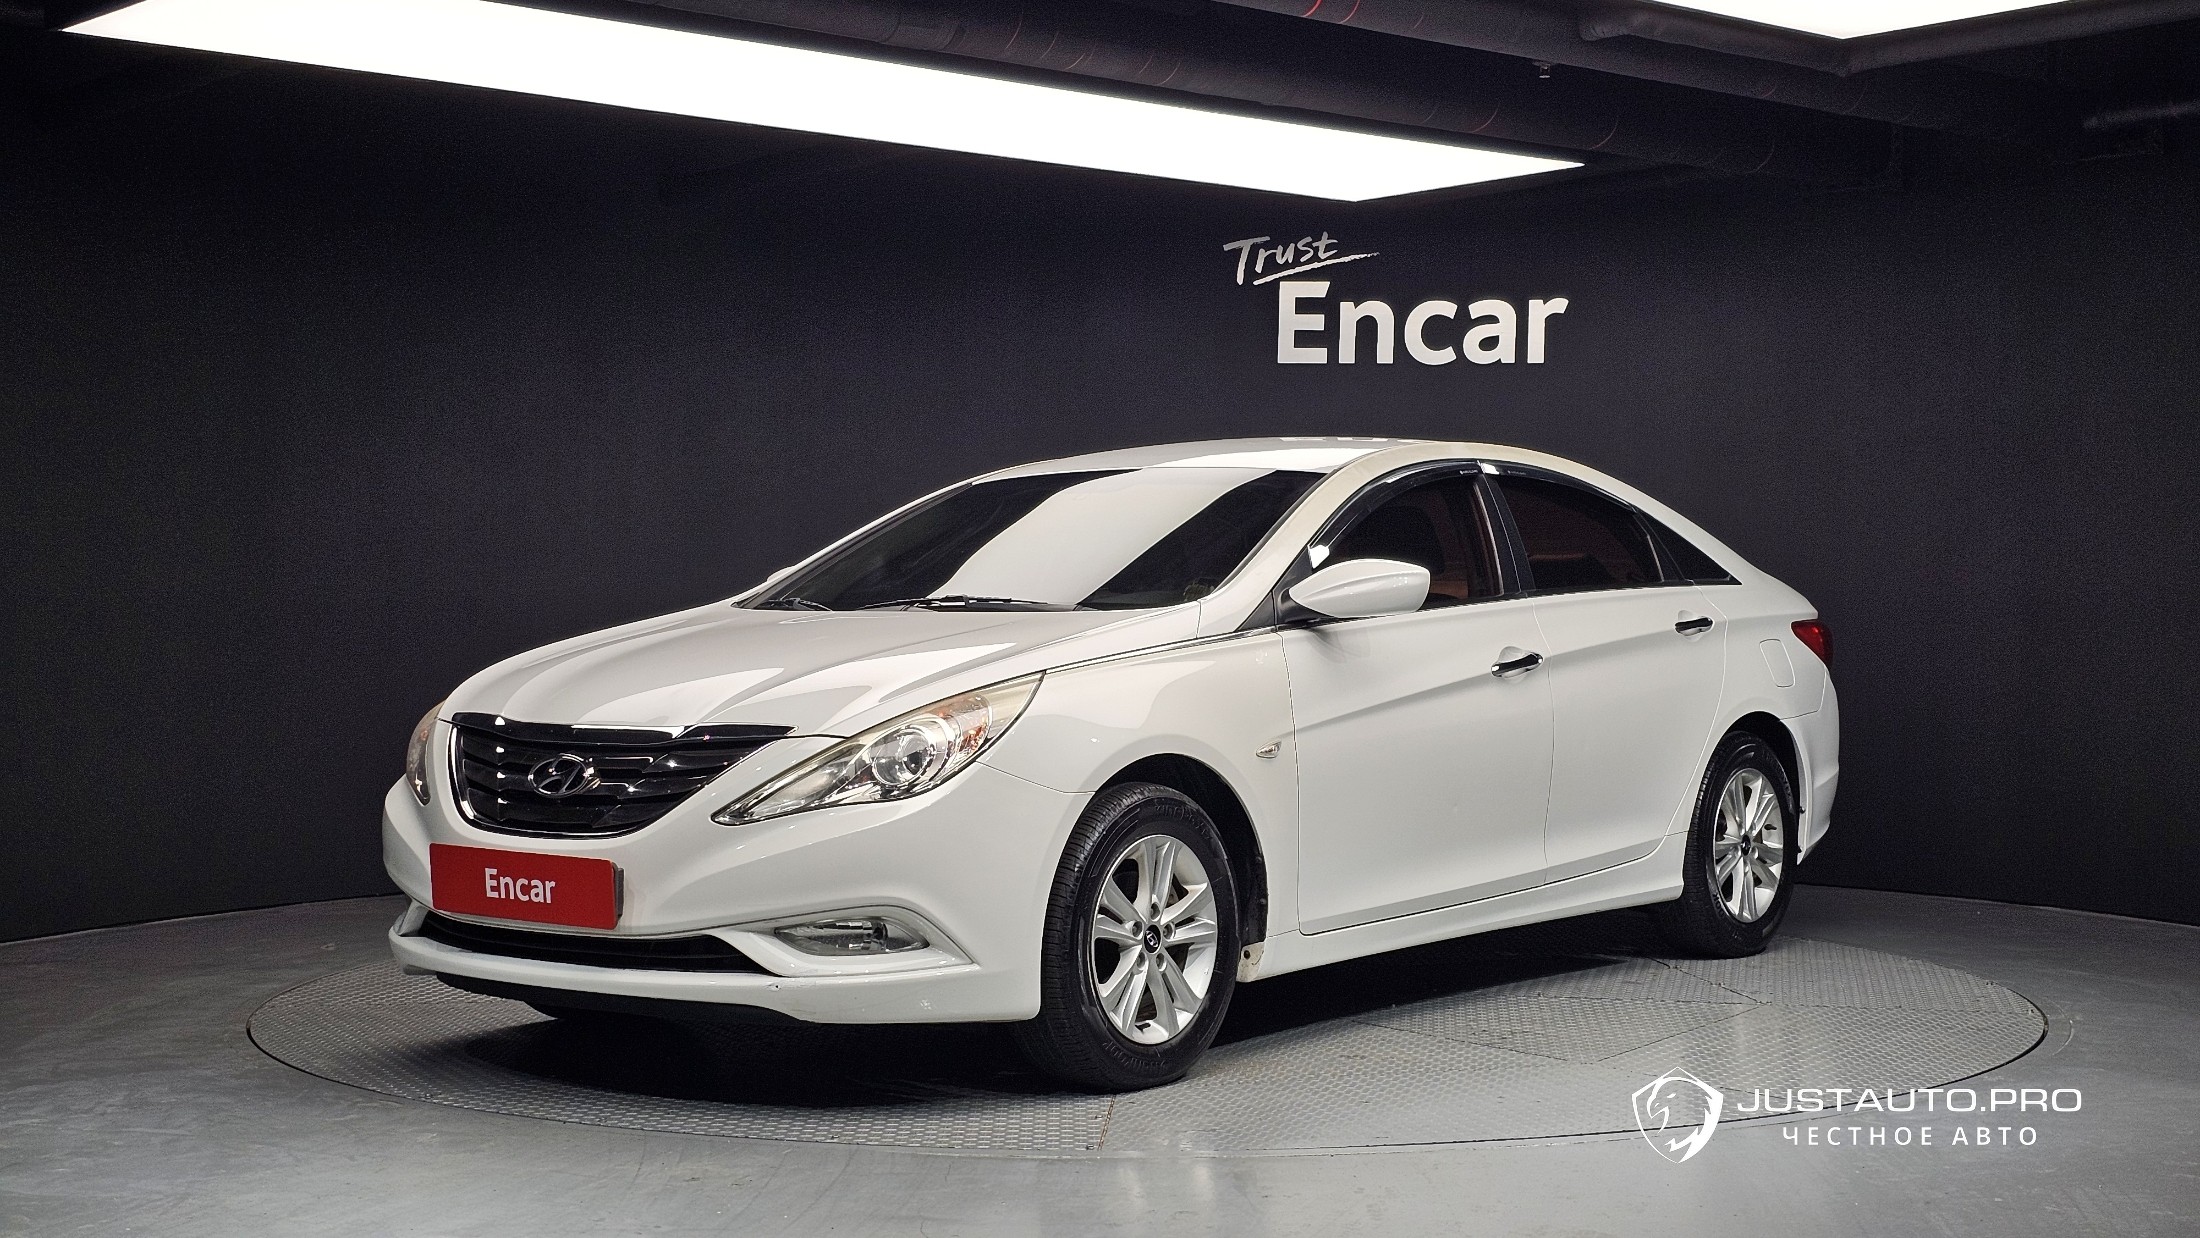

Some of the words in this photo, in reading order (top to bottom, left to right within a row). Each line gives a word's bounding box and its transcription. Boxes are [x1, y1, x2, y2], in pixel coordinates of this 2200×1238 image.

[1223, 231, 1339, 285] Trust
[1277, 280, 1570, 366] Encar
[484, 867, 556, 904] Encar
